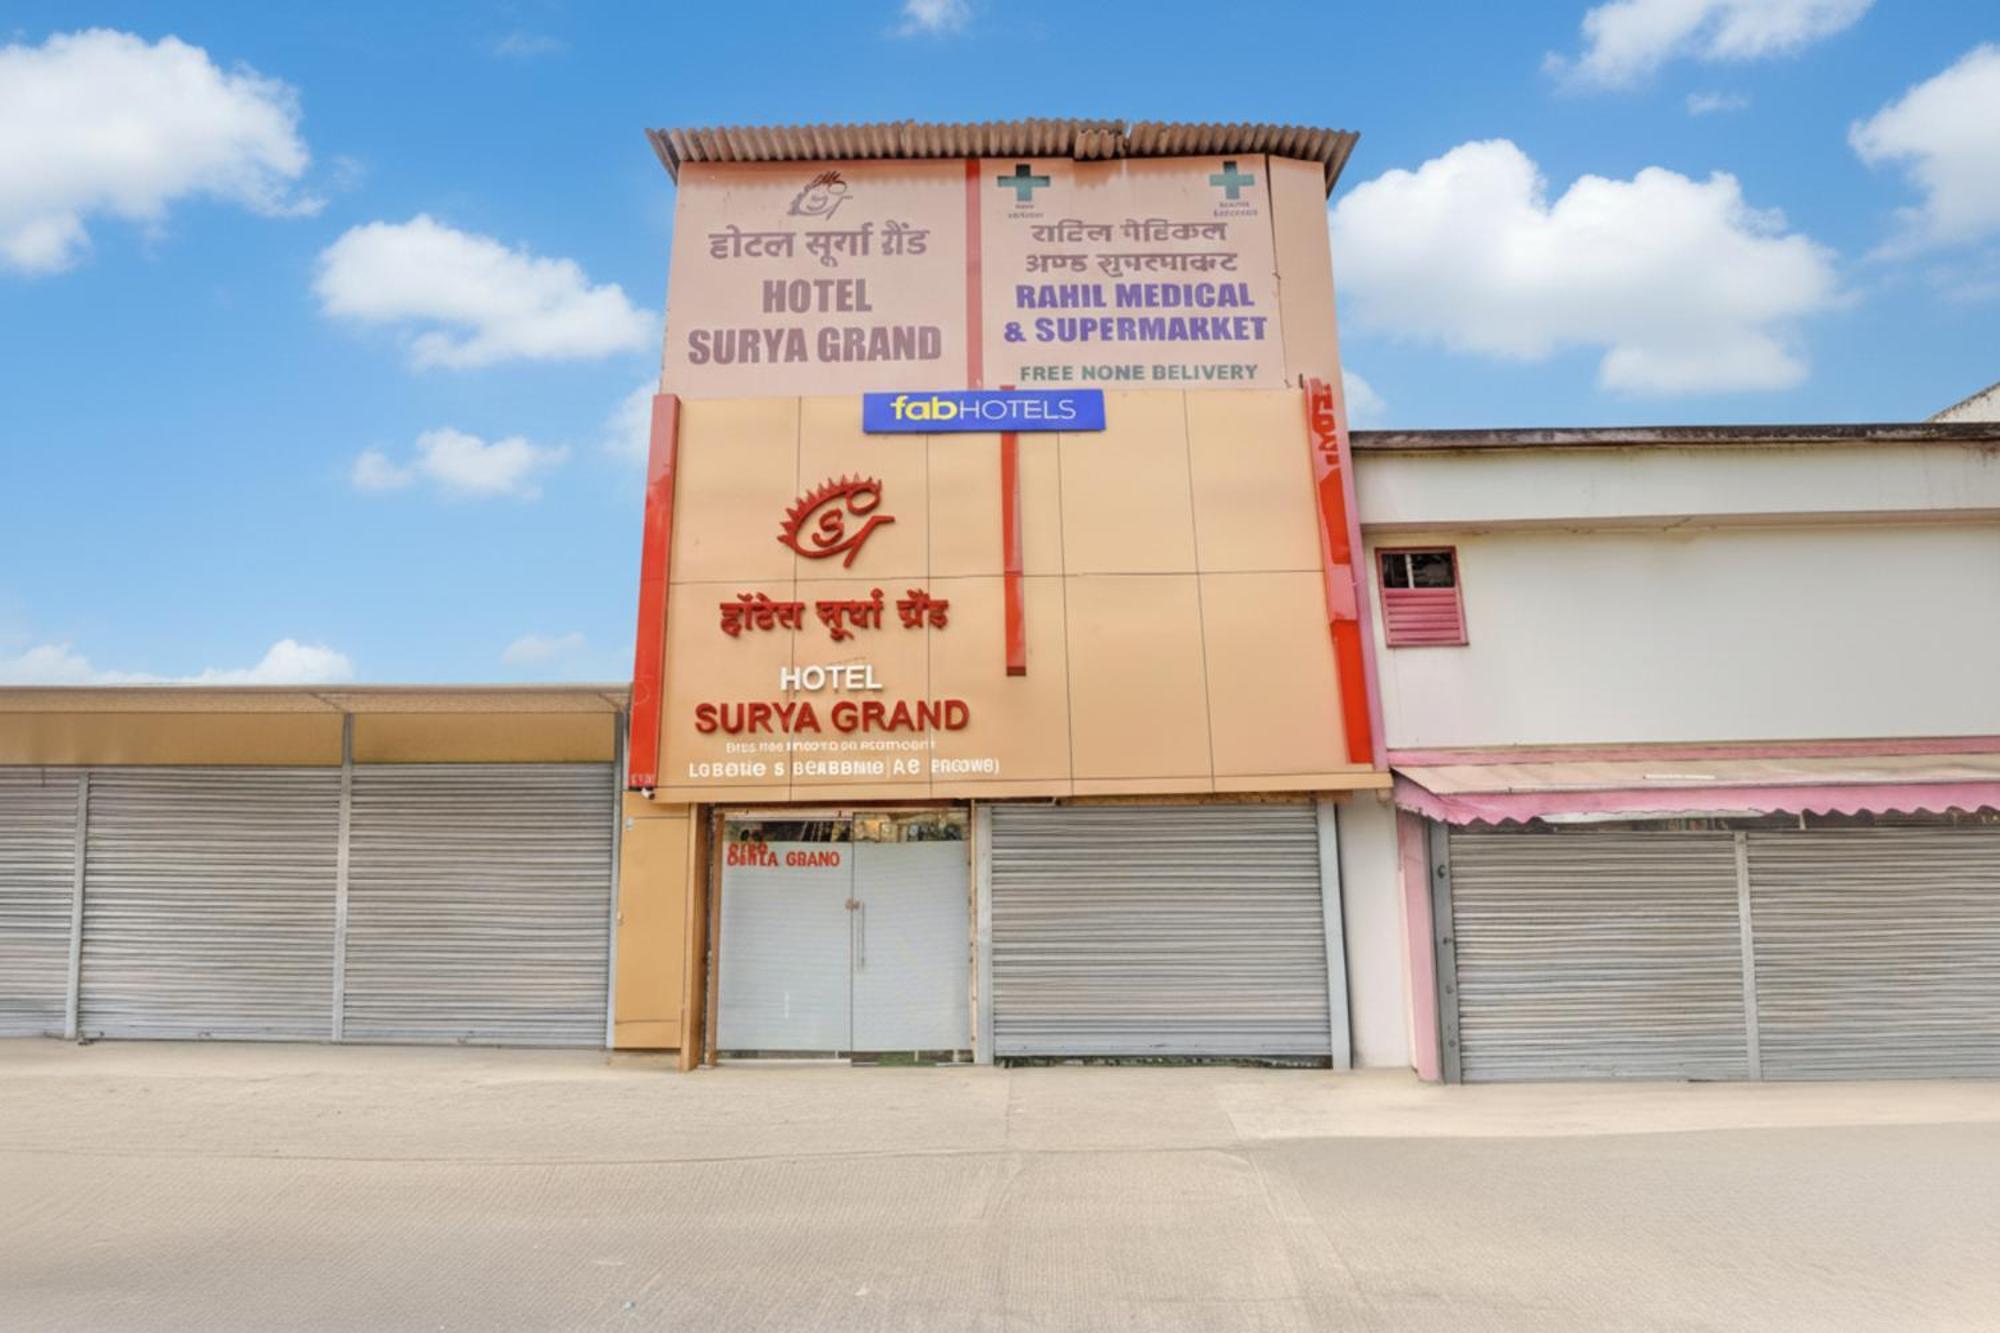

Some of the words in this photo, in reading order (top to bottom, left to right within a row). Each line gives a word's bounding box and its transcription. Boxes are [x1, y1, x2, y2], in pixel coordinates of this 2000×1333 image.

[708, 224, 796, 259] होटल
[762, 279, 872, 313] HOTEL
[1016, 284, 1107, 309] RAHIL
[1115, 283, 1255, 308] MEDICAL
[688, 328, 808, 365] SURYA
[817, 326, 942, 362] GRAND
[1004, 321, 1026, 342] &
[1020, 366, 1073, 381] FREE
[779, 664, 883, 691] HOTEL
[695, 702, 821, 734] SURYA
[831, 699, 970, 733] GRAND
